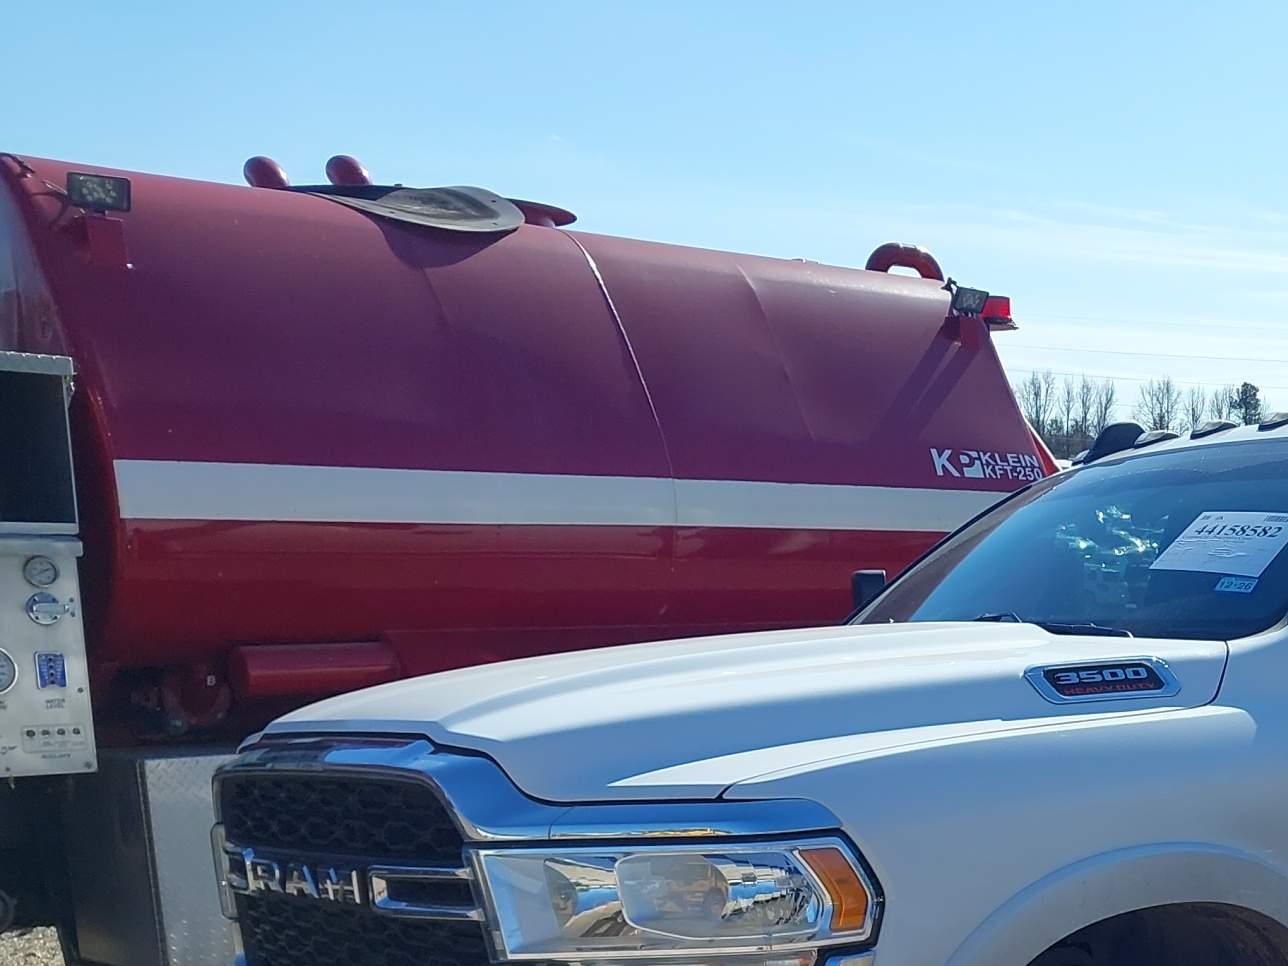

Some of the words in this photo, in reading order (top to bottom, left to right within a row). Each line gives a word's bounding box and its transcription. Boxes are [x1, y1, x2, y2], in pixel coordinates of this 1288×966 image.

[980, 451, 1039, 468] KLEIN
[984, 465, 1042, 480] KFT-250
[1195, 524, 1283, 538] 44158582
[1055, 667, 1148, 684] 3500
[1063, 684, 1113, 695] HEAVY
[1117, 681, 1155, 692] DUTY
[242, 848, 361, 905] RAM
